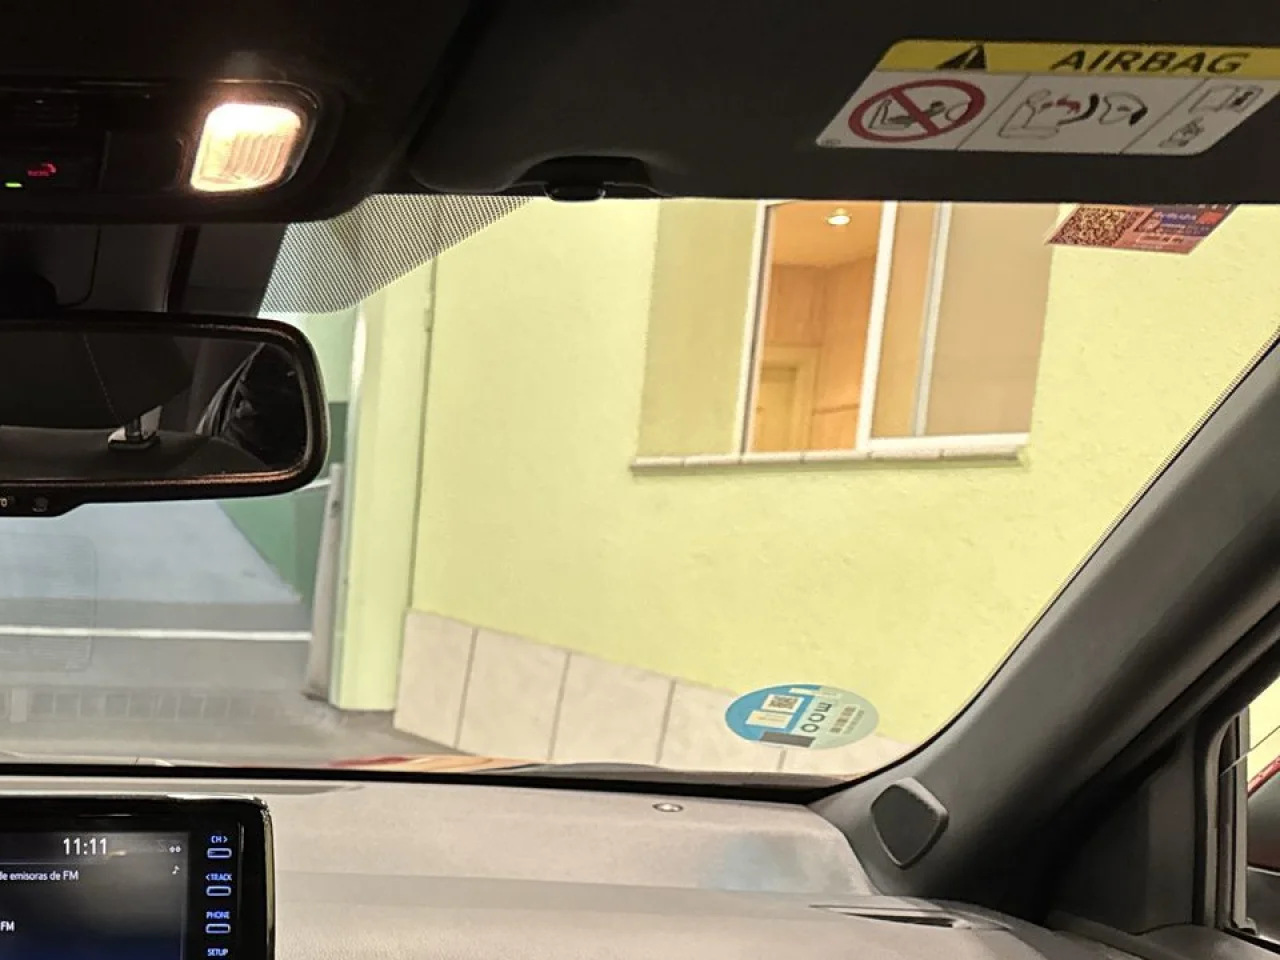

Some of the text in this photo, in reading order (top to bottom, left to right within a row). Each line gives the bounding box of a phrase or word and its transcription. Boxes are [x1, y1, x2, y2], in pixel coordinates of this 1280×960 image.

[1049, 50, 1250, 74] AIRBAG
[63, 838, 107, 855] 11:11
[9, 871, 48, 881] emisoras
[49, 871, 61, 881] de
[63, 871, 79, 881] FM
[206, 911, 229, 919] PHONE
[0, 921, 15, 931] FM
[208, 949, 228, 957] SETUP
